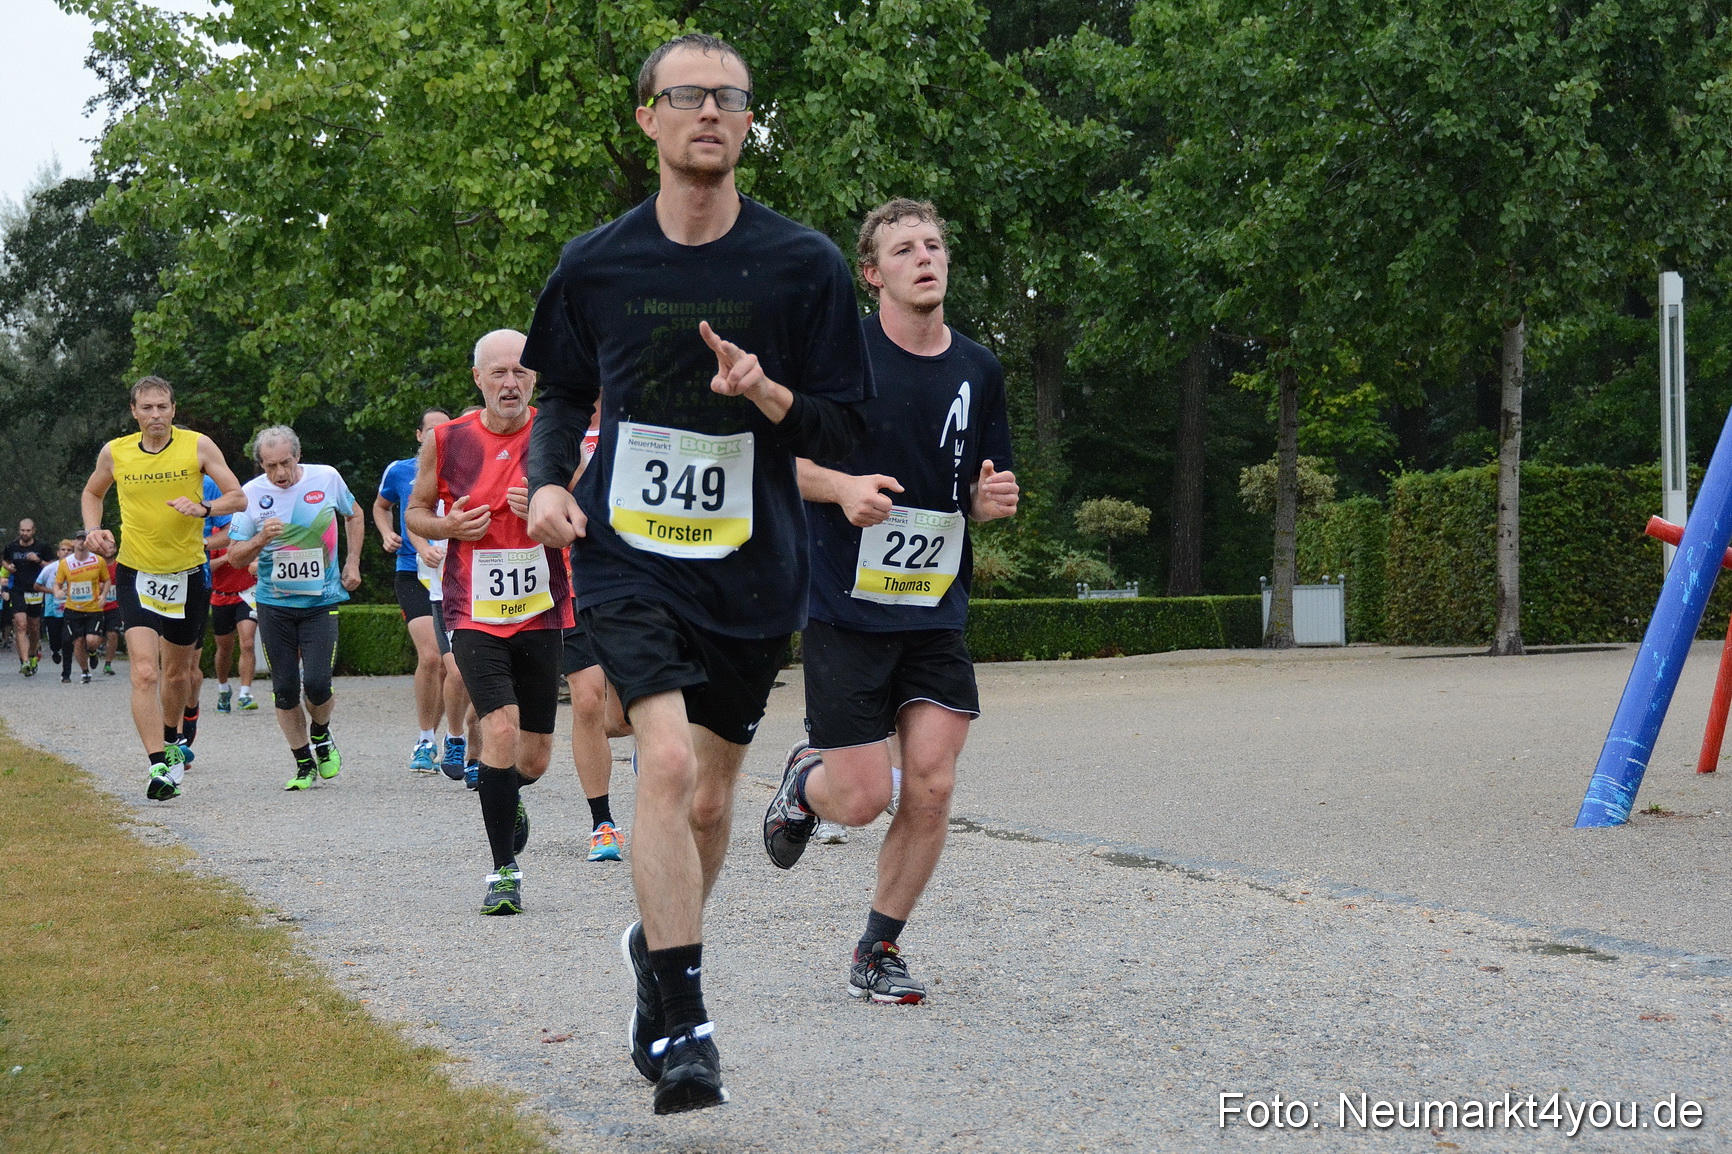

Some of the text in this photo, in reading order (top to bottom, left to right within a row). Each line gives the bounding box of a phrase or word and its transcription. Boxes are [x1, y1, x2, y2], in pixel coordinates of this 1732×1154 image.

[624, 299, 753, 316] 1. Neumarkter
[671, 316, 752, 330] STATLAUF
[628, 438, 672, 451] NeuerMarkt
[680, 435, 742, 456] BOCK
[124, 469, 189, 481] KLINGELE
[642, 459, 726, 512] 349
[615, 498, 622, 506] C
[646, 519, 713, 542] Torsten
[882, 530, 945, 569] 222
[277, 560, 320, 579] 3049
[489, 566, 536, 596] 315
[884, 576, 931, 592] Thomas
[71, 586, 91, 595] 2813
[146, 580, 179, 601] 342
[502, 603, 526, 615] Peter
